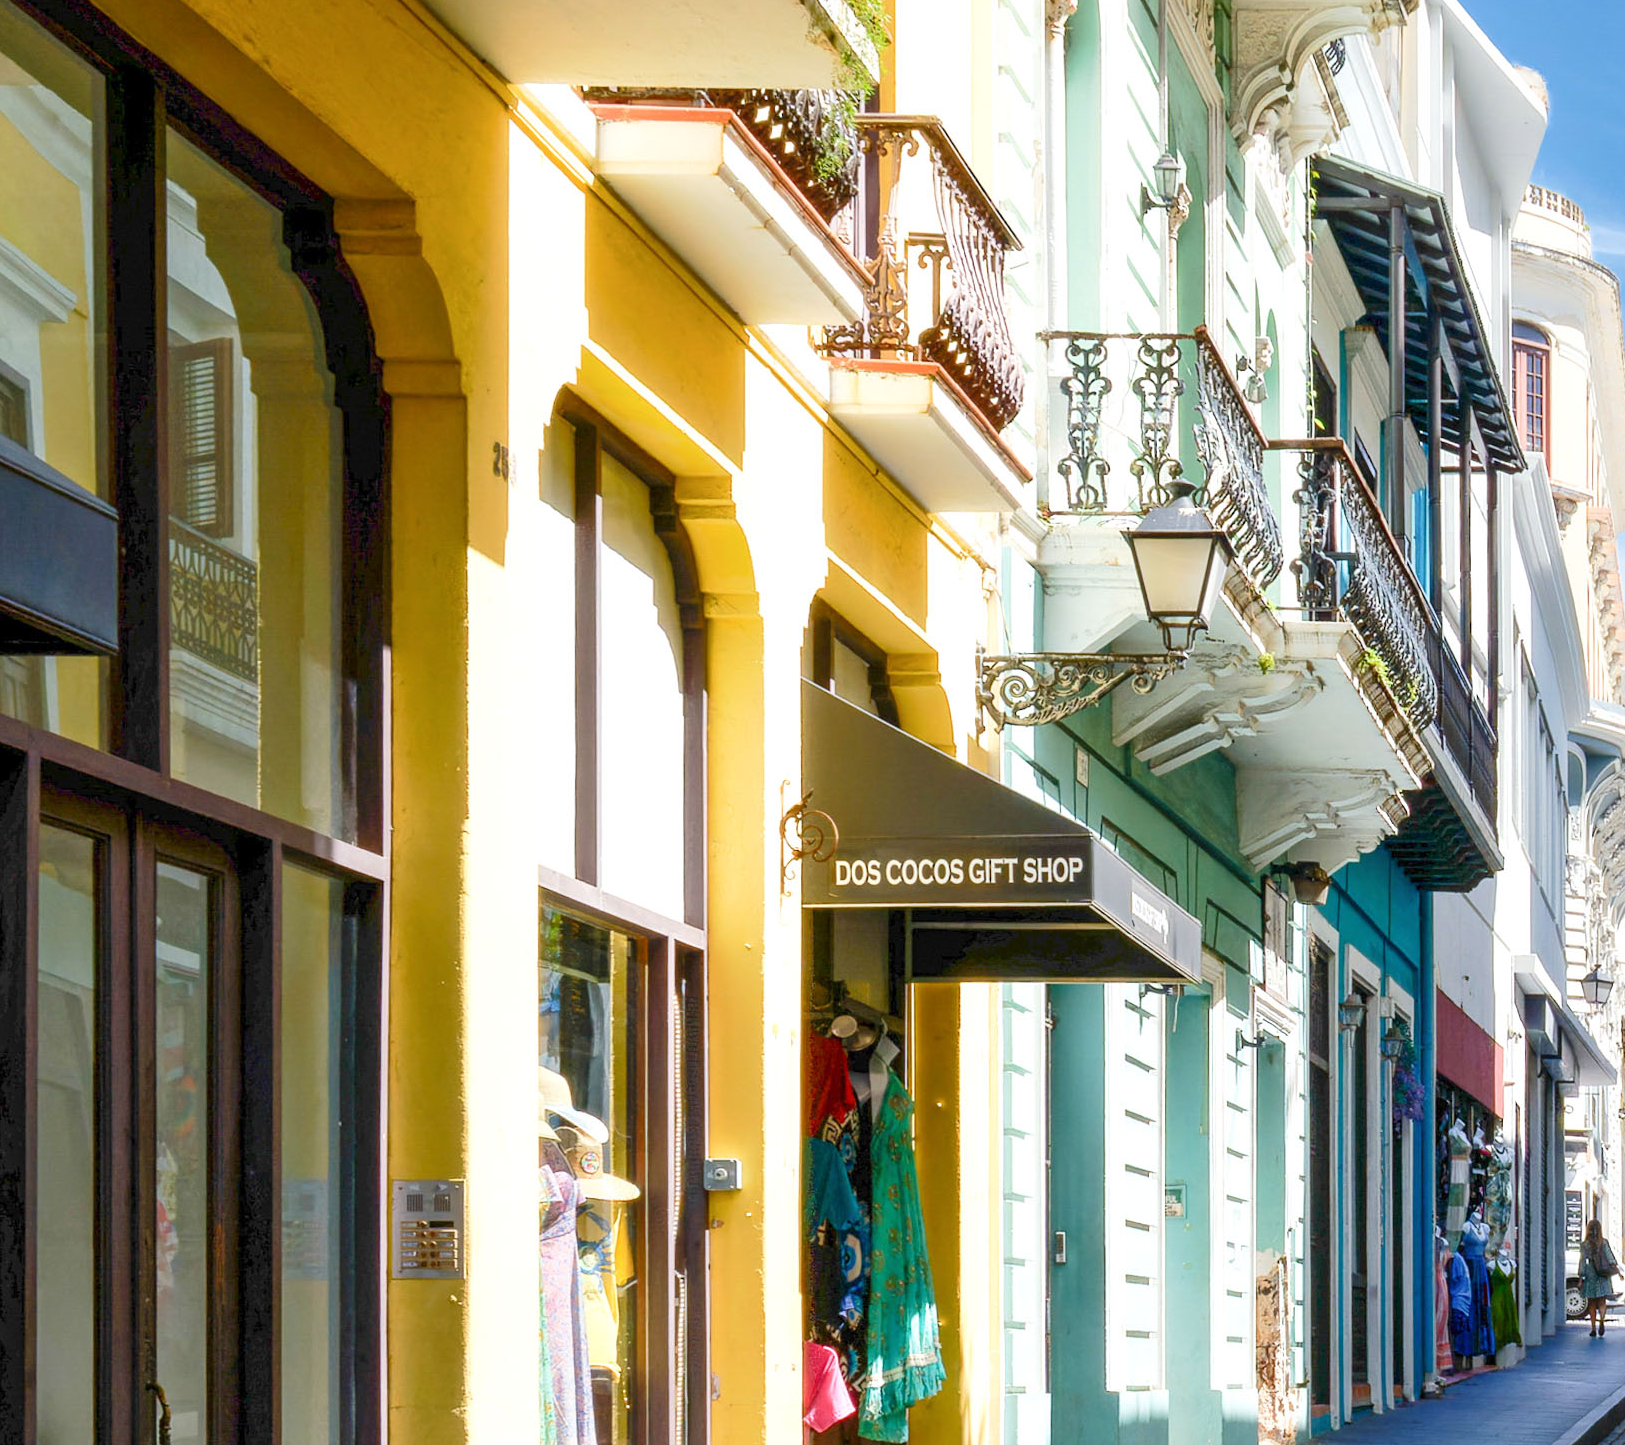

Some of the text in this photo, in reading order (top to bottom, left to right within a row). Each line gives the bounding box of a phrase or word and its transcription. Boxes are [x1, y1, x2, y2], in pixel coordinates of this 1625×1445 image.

[835, 856, 1084, 886] DOS COCOS GIFT SHOP
